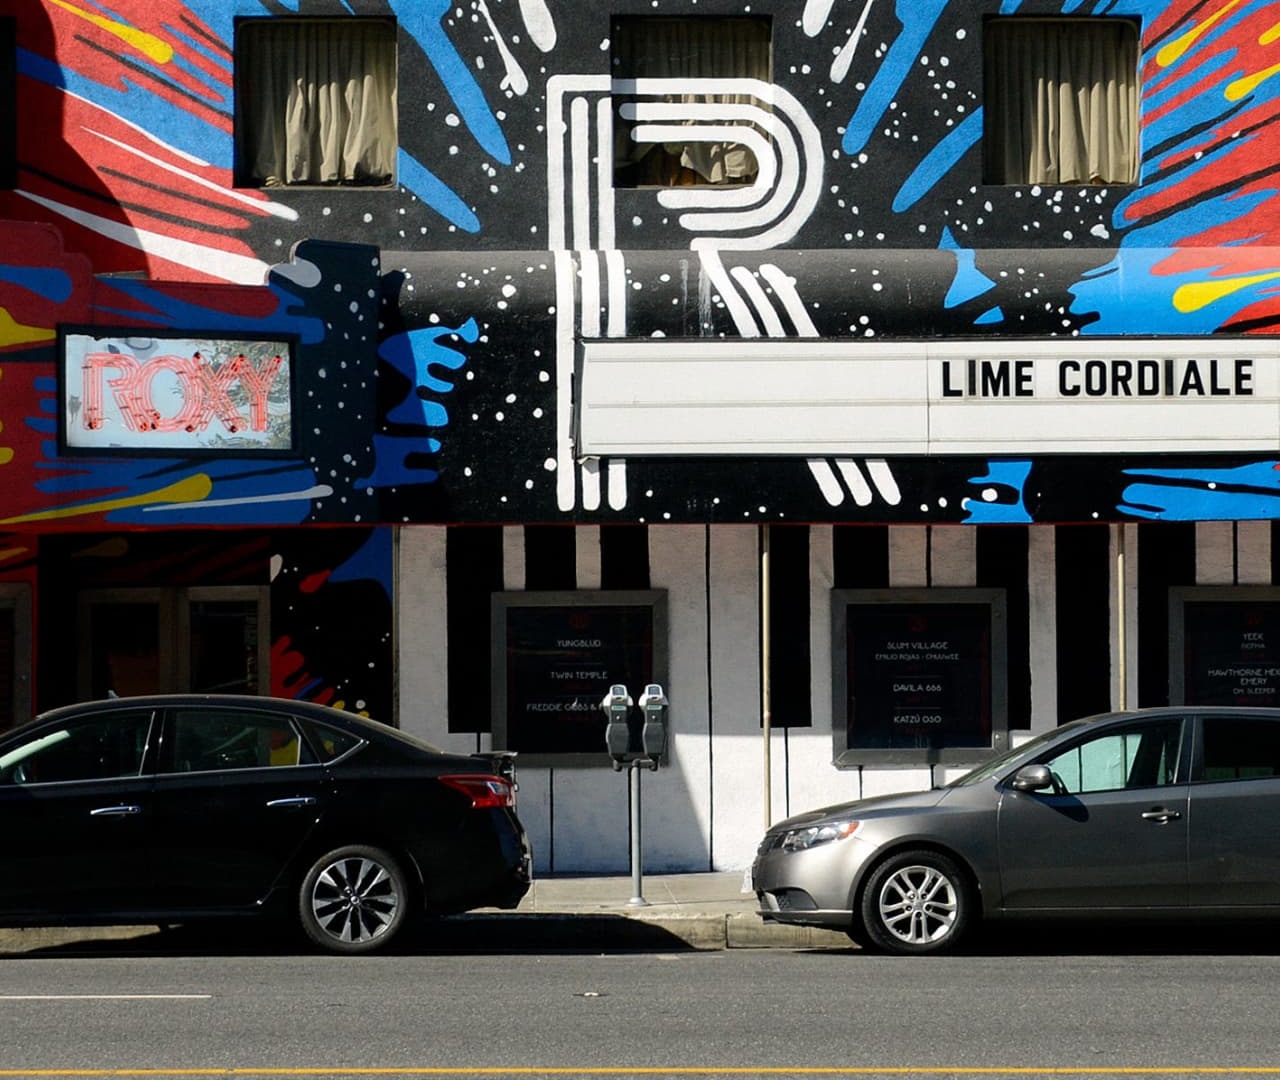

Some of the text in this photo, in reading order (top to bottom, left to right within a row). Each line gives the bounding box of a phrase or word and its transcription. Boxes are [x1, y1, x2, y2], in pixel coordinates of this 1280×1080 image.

[942, 359, 1254, 397] LIME CORDIALE
[82, 351, 283, 433] ROXY
[886, 641, 949, 650] SLUM VILLAGE
[550, 671, 609, 680] TWIN TEMPLE
[1207, 668, 1263, 677] HAWTHORNE
[1240, 677, 1268, 686] EMERY
[892, 683, 924, 693] DAVILA
[526, 703, 563, 712] FREDDIE
[921, 715, 942, 724] OSO
